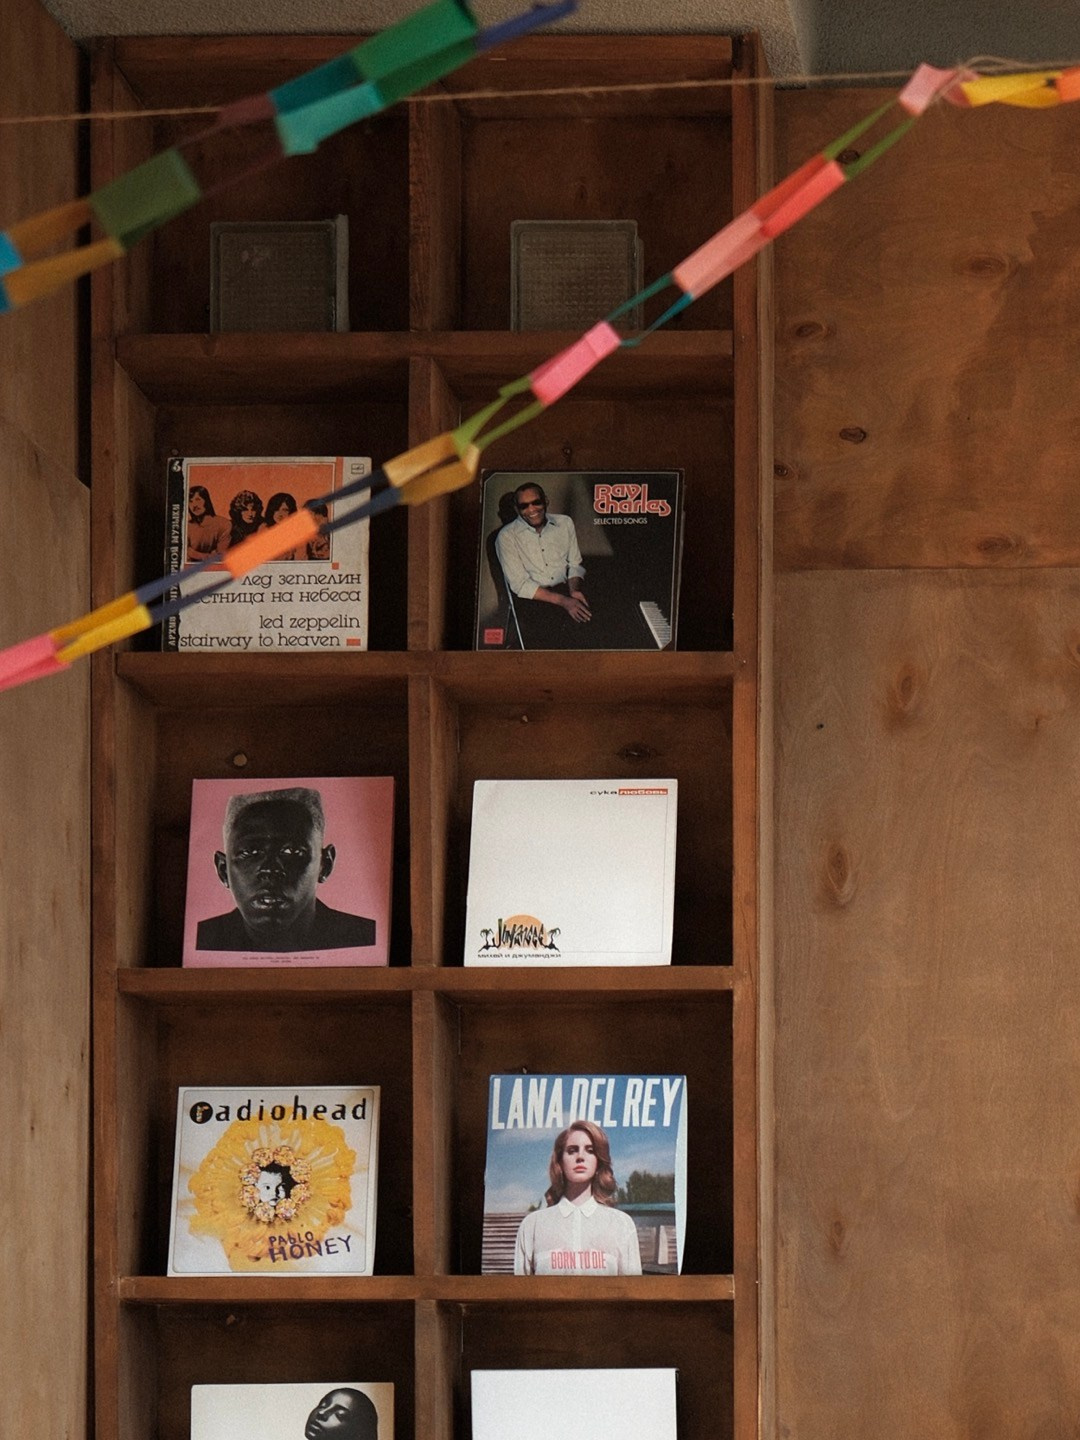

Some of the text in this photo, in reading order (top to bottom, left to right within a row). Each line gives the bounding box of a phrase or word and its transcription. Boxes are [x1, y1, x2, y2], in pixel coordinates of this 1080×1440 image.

[594, 484, 642, 500] Ray
[594, 494, 672, 516] Charles
[170, 503, 180, 543] МУЗЫКИ
[594, 517, 648, 526] SELECTED SONGS
[241, 573, 361, 588] лед зеппелин
[190, 588, 361, 606] стница на небеса
[260, 614, 361, 631] led zeppelin
[180, 633, 340, 650] stairway to heaven
[492, 1078, 682, 1130] LANA DEL REY
[268, 1234, 352, 1263] HONEY
[551, 1252, 607, 1270] BORN TO DIE
